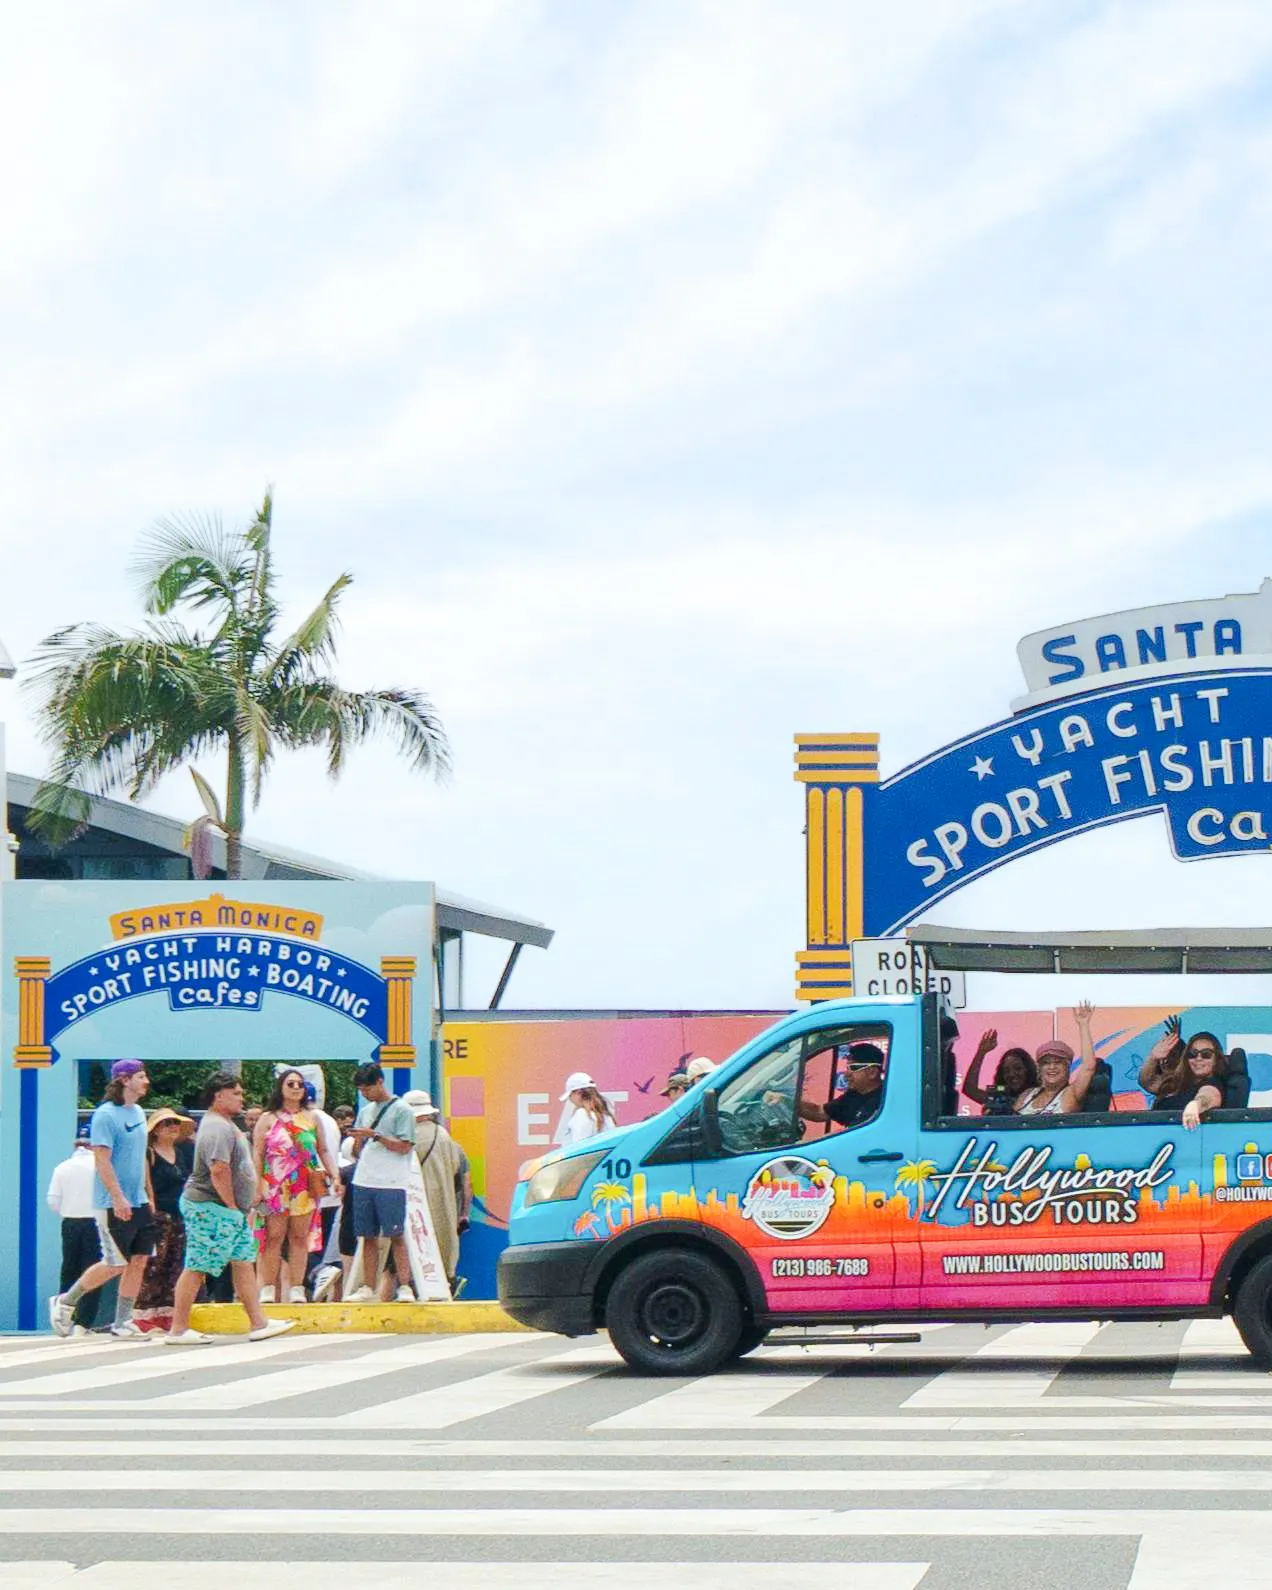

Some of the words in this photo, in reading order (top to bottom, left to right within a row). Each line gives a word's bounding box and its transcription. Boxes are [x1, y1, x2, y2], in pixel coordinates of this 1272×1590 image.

[1041, 618, 1242, 685] SANTA
[1010, 687, 1229, 766] YACHT
[906, 771, 1073, 888] SPORT
[120, 910, 203, 938] SANTA
[217, 906, 316, 937] MONICA
[105, 936, 199, 971] YACHT
[216, 936, 332, 971] HARBOR
[878, 950, 923, 970] ROA
[61, 973, 133, 1021] SPORT
[143, 957, 241, 989] FISHING
[266, 963, 370, 1020] BOATING
[178, 981, 260, 1008] cafes
[602, 1158, 632, 1180] 10
[928, 1136, 1175, 1223] Hollywood
[760, 1209, 780, 1219] BUS
[788, 1209, 819, 1219] TOURS
[974, 1201, 1024, 1226] BUS
[1050, 1199, 1138, 1225] TOURS
[772, 1258, 804, 1277] (213)
[942, 1251, 1165, 1275] WWW.HOLLYWOODBUSTOURS.COM
